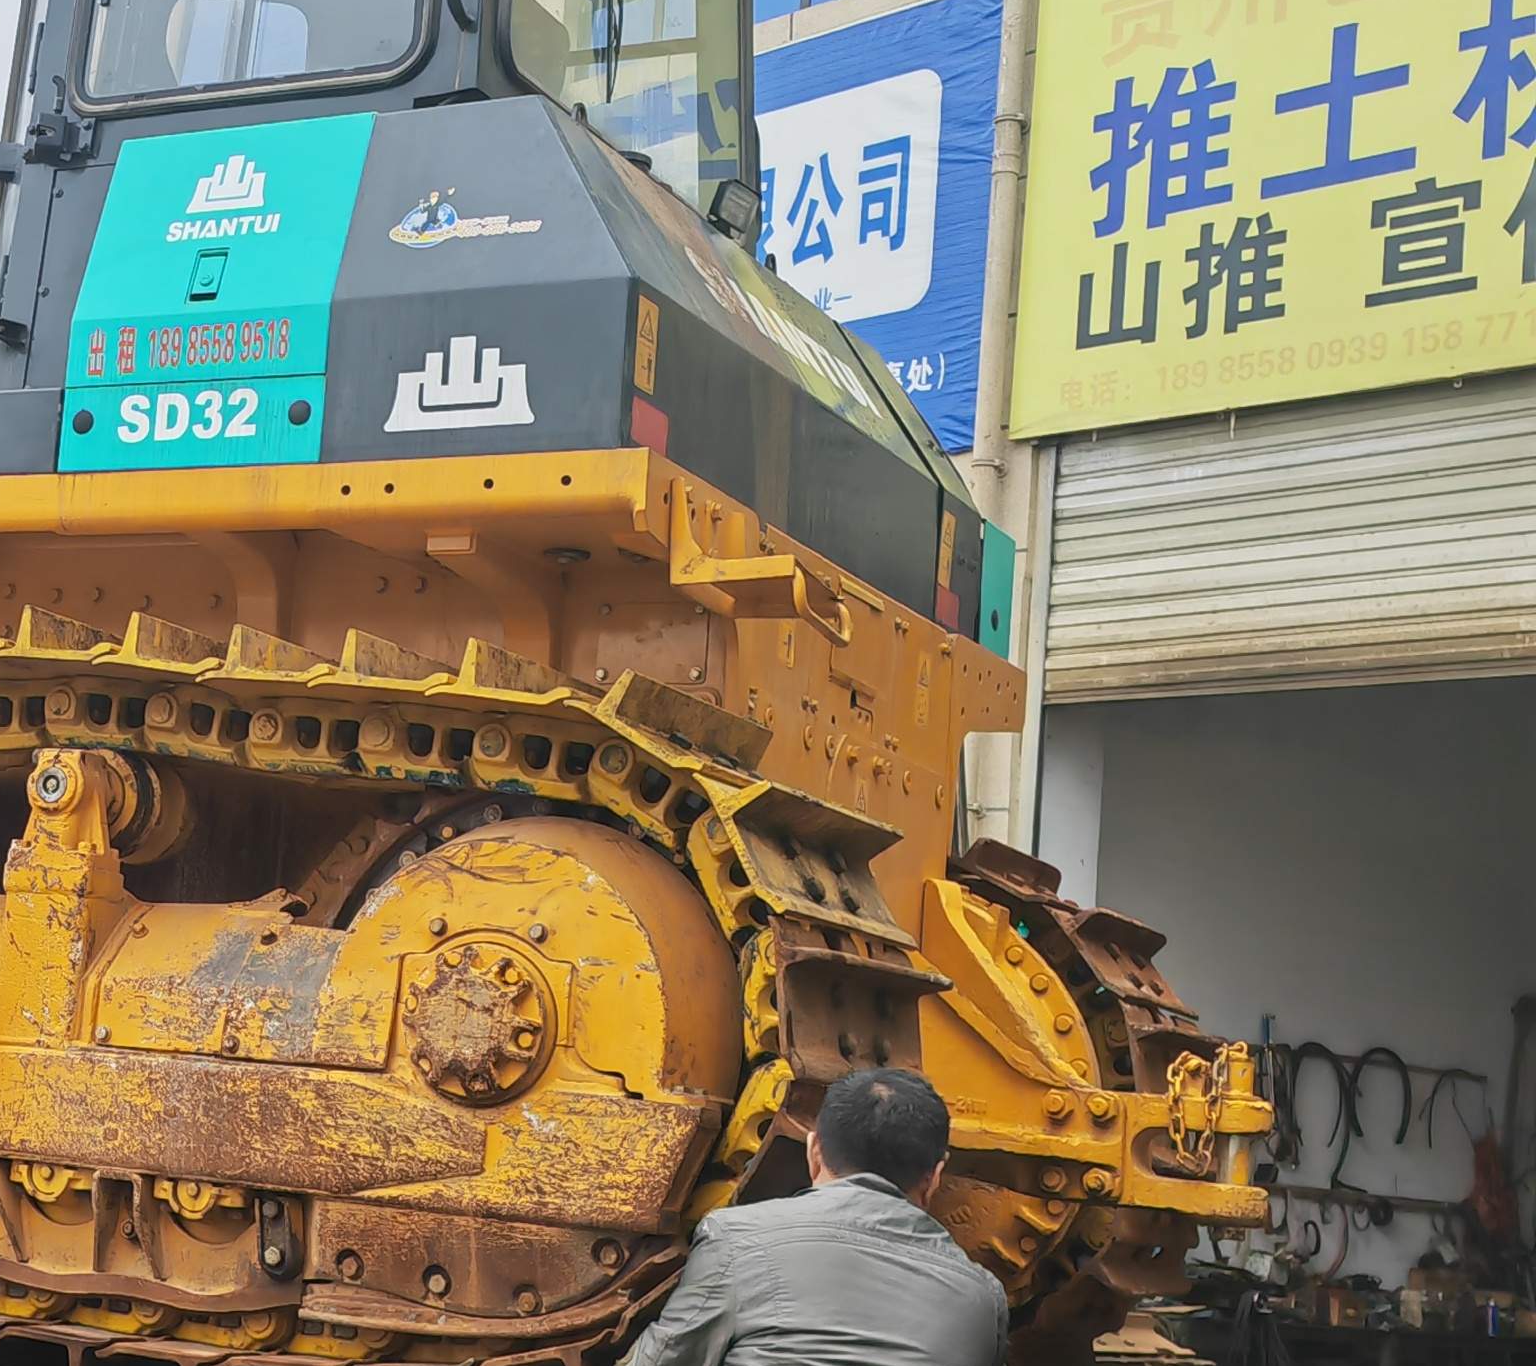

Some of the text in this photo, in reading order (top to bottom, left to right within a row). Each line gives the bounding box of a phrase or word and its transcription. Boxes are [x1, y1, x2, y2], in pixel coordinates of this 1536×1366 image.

[165, 213, 281, 242] SHANTUI
[1075, 212, 1287, 350] 山推
[149, 327, 183, 369] 189
[186, 323, 236, 367] 8558
[239, 318, 290, 363] 9518
[1158, 360, 1208, 393] 189
[1217, 346, 1297, 385] 8558
[1306, 331, 1387, 371] 0939
[1402, 319, 1463, 357] 158
[117, 388, 259, 444] SD32
